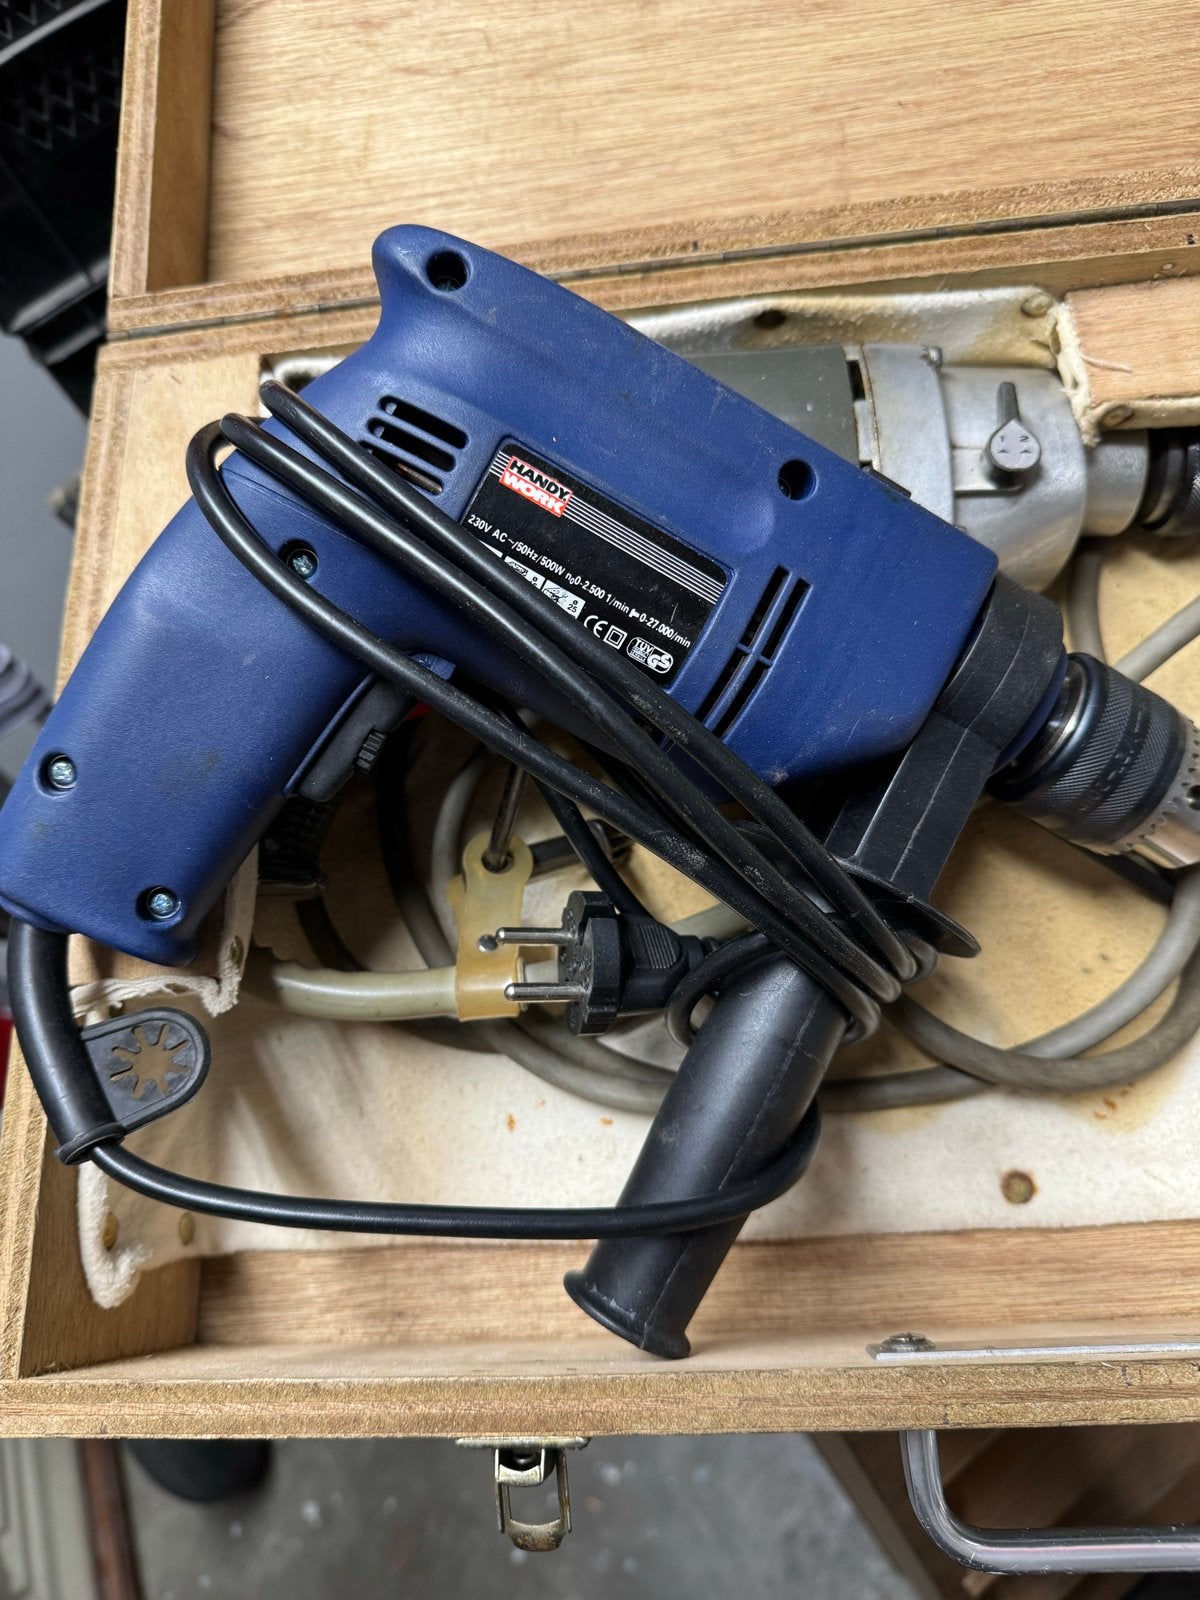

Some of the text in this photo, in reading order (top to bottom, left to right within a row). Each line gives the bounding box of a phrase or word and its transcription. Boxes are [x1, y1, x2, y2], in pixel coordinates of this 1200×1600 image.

[1019, 435, 1030, 443] 2
[504, 471, 565, 515] WORK
[510, 460, 571, 499] HANDY
[468, 514, 493, 533] 230V
[605, 593, 631, 614] 1/min
[639, 612, 691, 649] 0-27.000/min
[567, 604, 578, 613] 25
[647, 653, 671, 669] GS
